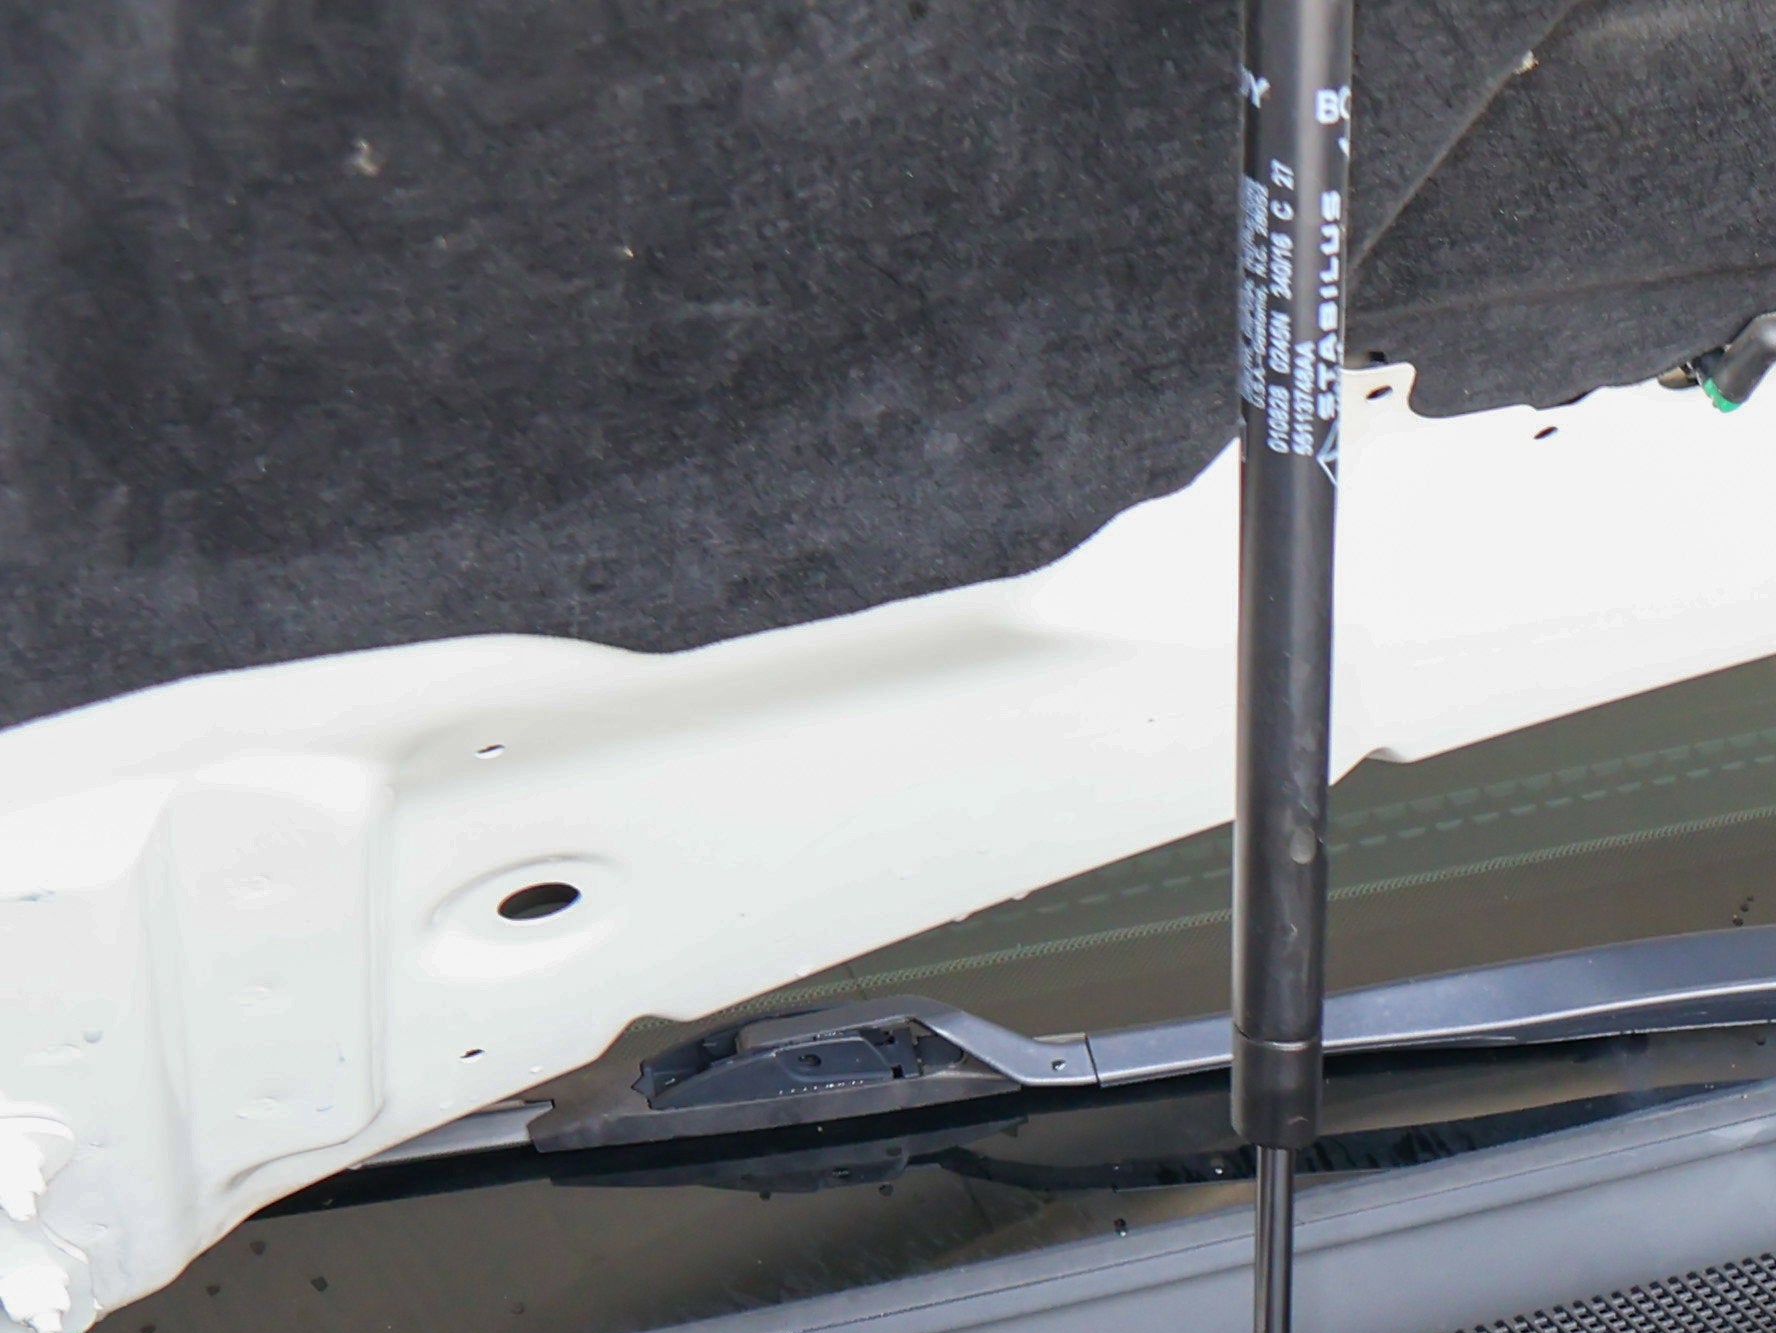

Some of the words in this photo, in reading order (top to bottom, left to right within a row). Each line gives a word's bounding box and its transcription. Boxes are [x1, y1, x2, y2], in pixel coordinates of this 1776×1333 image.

[1272, 159, 1295, 191] 27
[1273, 200, 1295, 221] C
[1317, 190, 1341, 420] STABILUS
